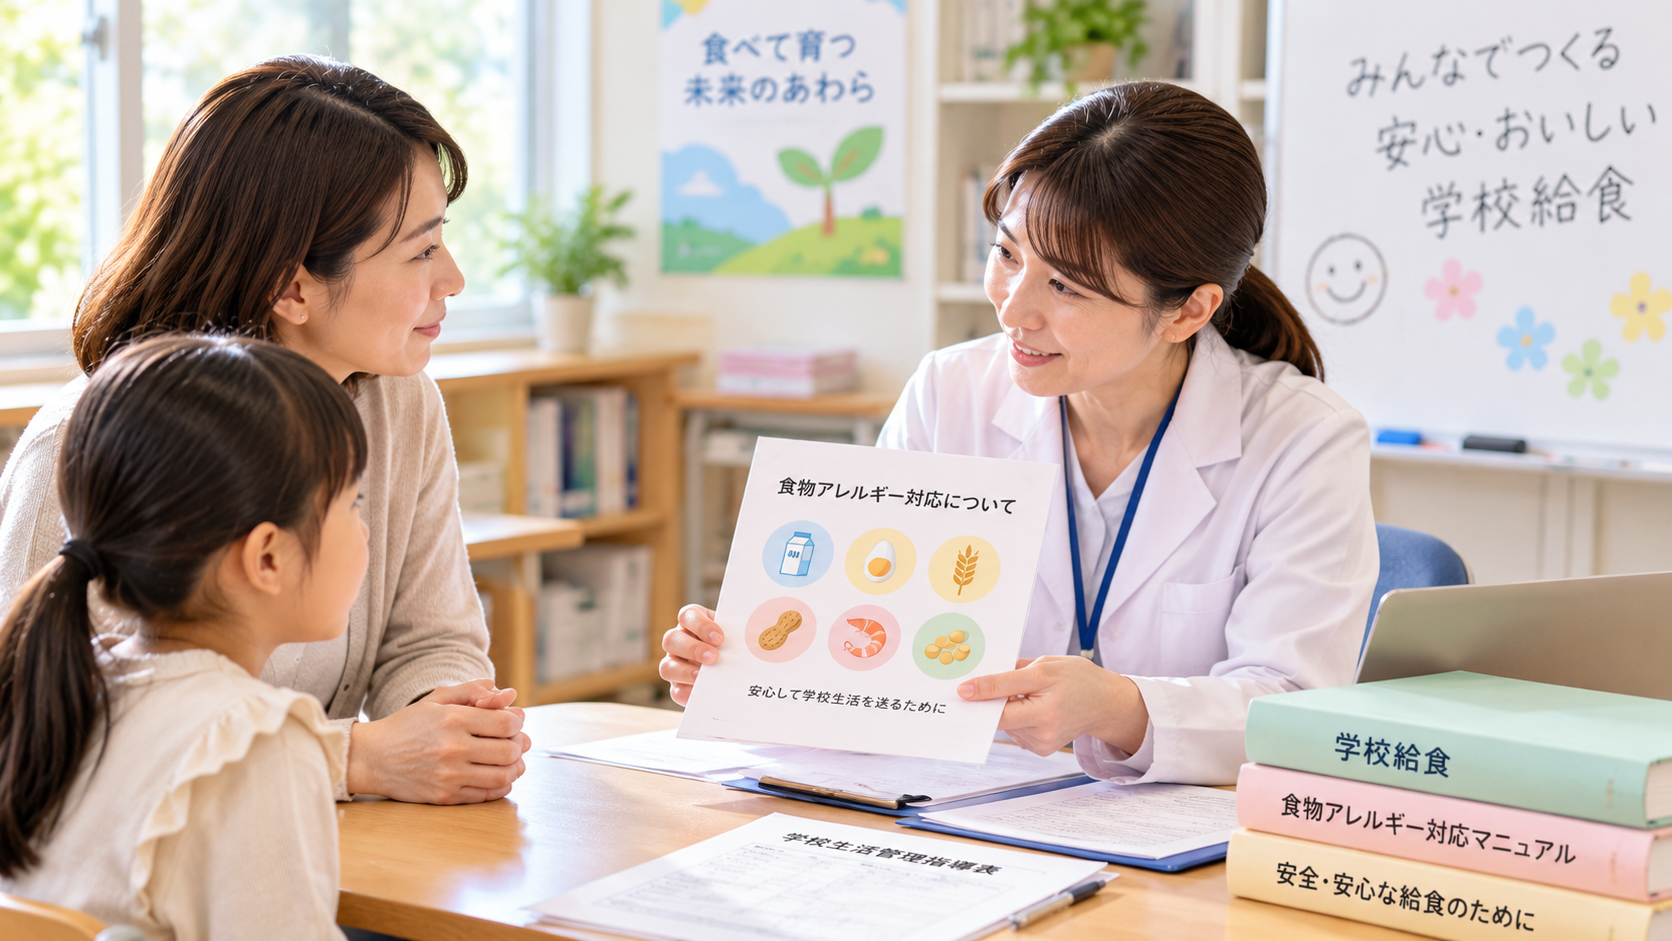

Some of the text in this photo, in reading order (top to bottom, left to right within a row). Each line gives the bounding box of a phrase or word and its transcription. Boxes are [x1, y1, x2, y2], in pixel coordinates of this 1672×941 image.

[701, 28, 856, 67] 食べて育つ
[1346, 27, 1621, 98] みんなでつくる
[685, 70, 875, 107] 未来のあわら
[1375, 102, 1657, 171] 安心・おいしい
[1421, 164, 1635, 240] 学校給食
[777, 477, 1017, 515] 食物アレルギー対応について
[747, 684, 947, 714] 安心して学校生活を送るために
[1334, 732, 1451, 778] 学校給食
[1280, 793, 1577, 864] 食物アレルギー対応マニュアル
[1276, 861, 1536, 932] 安全・安心な給食のために
